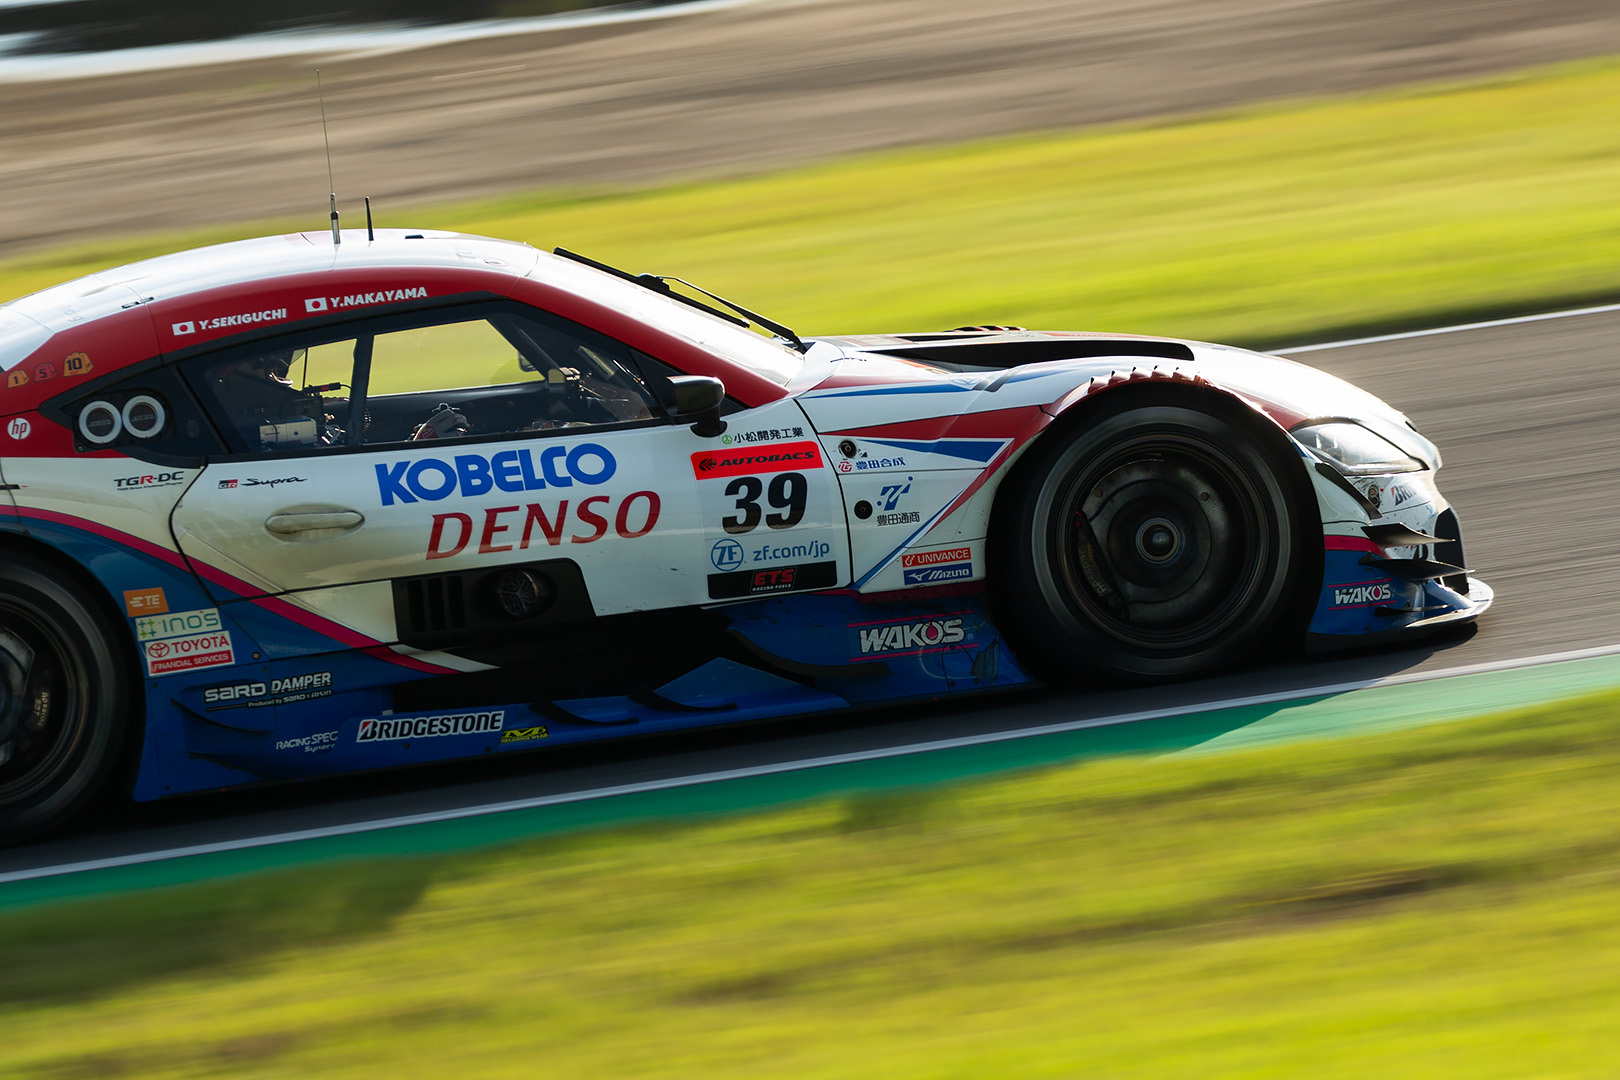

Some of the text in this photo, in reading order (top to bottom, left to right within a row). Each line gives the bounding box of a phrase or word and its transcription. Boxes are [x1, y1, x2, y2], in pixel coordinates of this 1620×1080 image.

[330, 286, 428, 308] Y.NAKAYAMA
[199, 308, 287, 330] Y.SEKIGUCHI
[66, 358, 82, 371] 10
[13, 376, 19, 385] 1
[39, 368, 47, 379] 5
[11, 419, 28, 439] hp
[733, 427, 805, 444] 小松開発工業
[719, 451, 815, 467] AUTOBACS
[114, 471, 184, 488] TGR-DC
[241, 475, 308, 488] Supra
[374, 443, 617, 506] KOBELCO
[722, 472, 808, 535] 39
[425, 490, 661, 560] DENSO
[876, 511, 921, 527] 豊田通商
[753, 540, 831, 562] zf.com/jp
[917, 550, 970, 564] UNIVANCE
[753, 569, 794, 585] ETS
[171, 635, 230, 653] TOYOTA
[153, 654, 230, 671] FINANCIAL SERVICES
[271, 672, 332, 694] DAMPER
[356, 711, 505, 743] BRIDGESTONE
